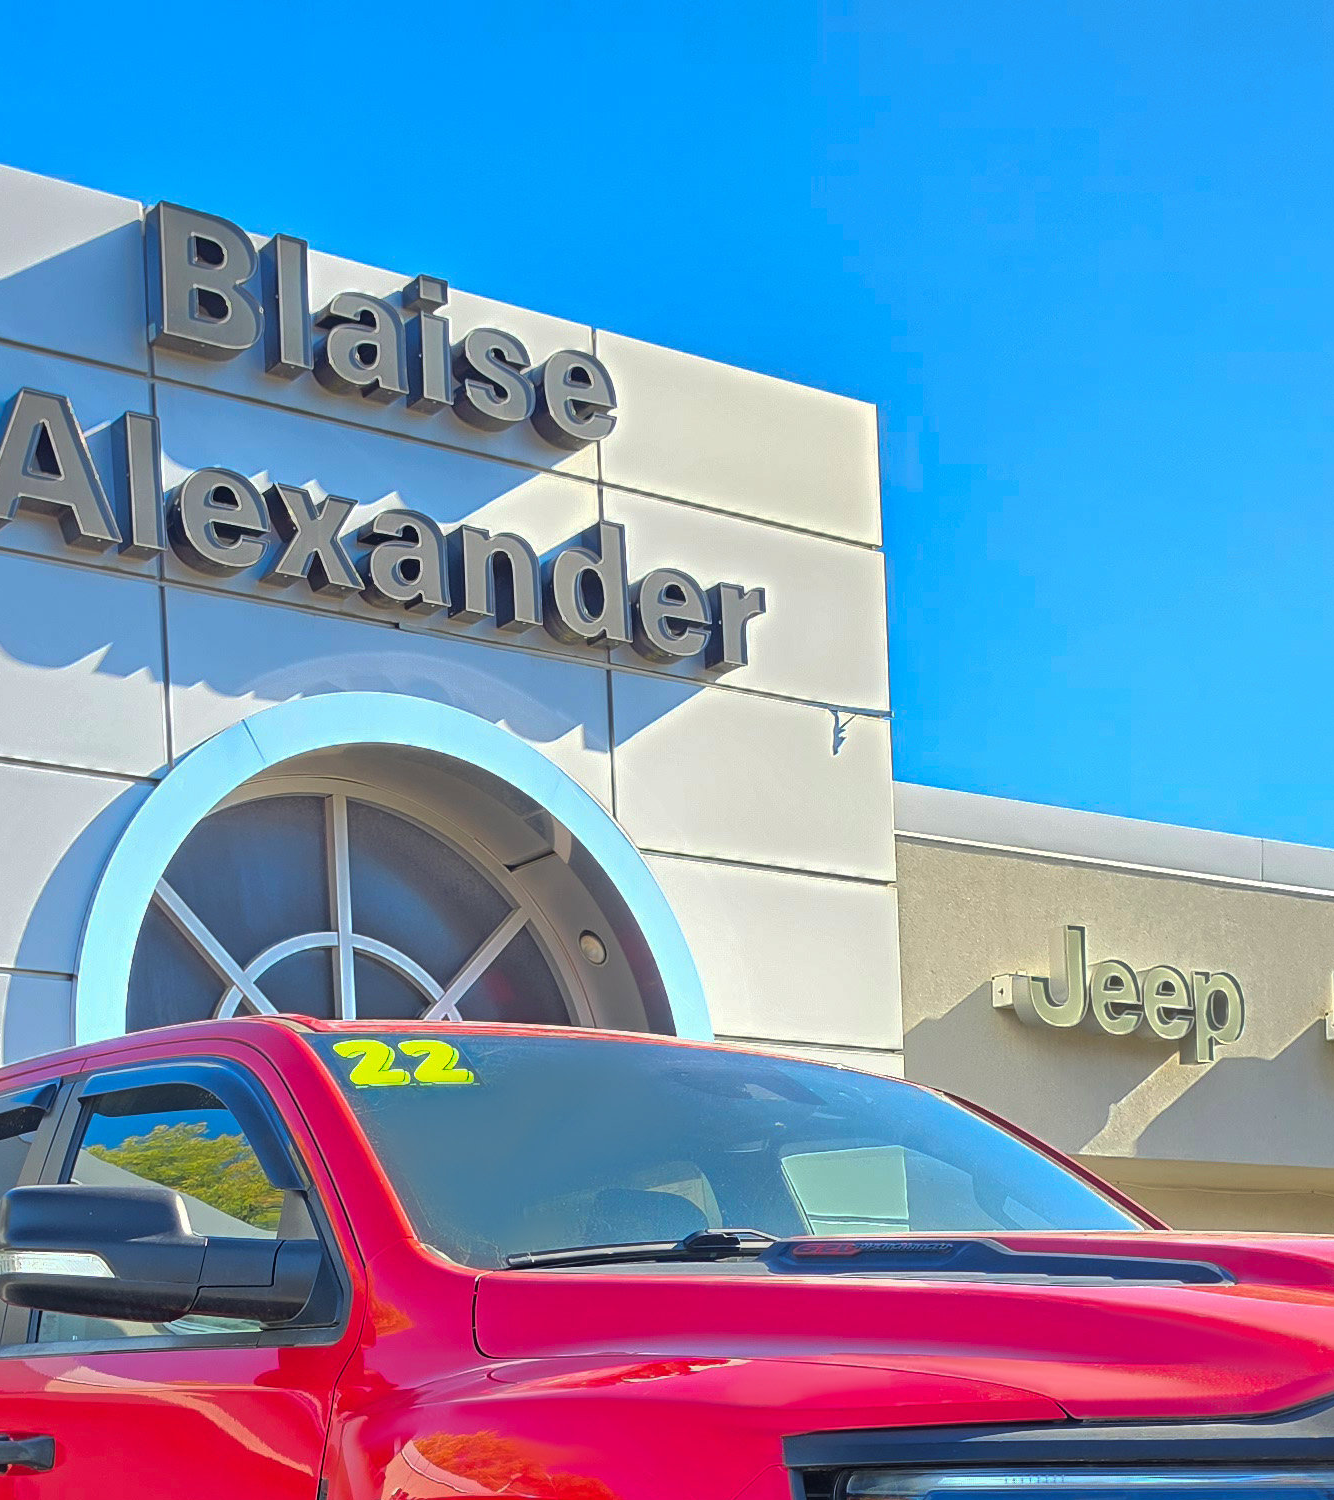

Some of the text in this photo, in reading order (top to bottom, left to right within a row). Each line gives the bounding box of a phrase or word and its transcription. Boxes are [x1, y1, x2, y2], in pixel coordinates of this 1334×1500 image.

[147, 201, 618, 451] Blaise
[332, 1038, 475, 1086] 22
[1017, 925, 1245, 1065] Jeep
